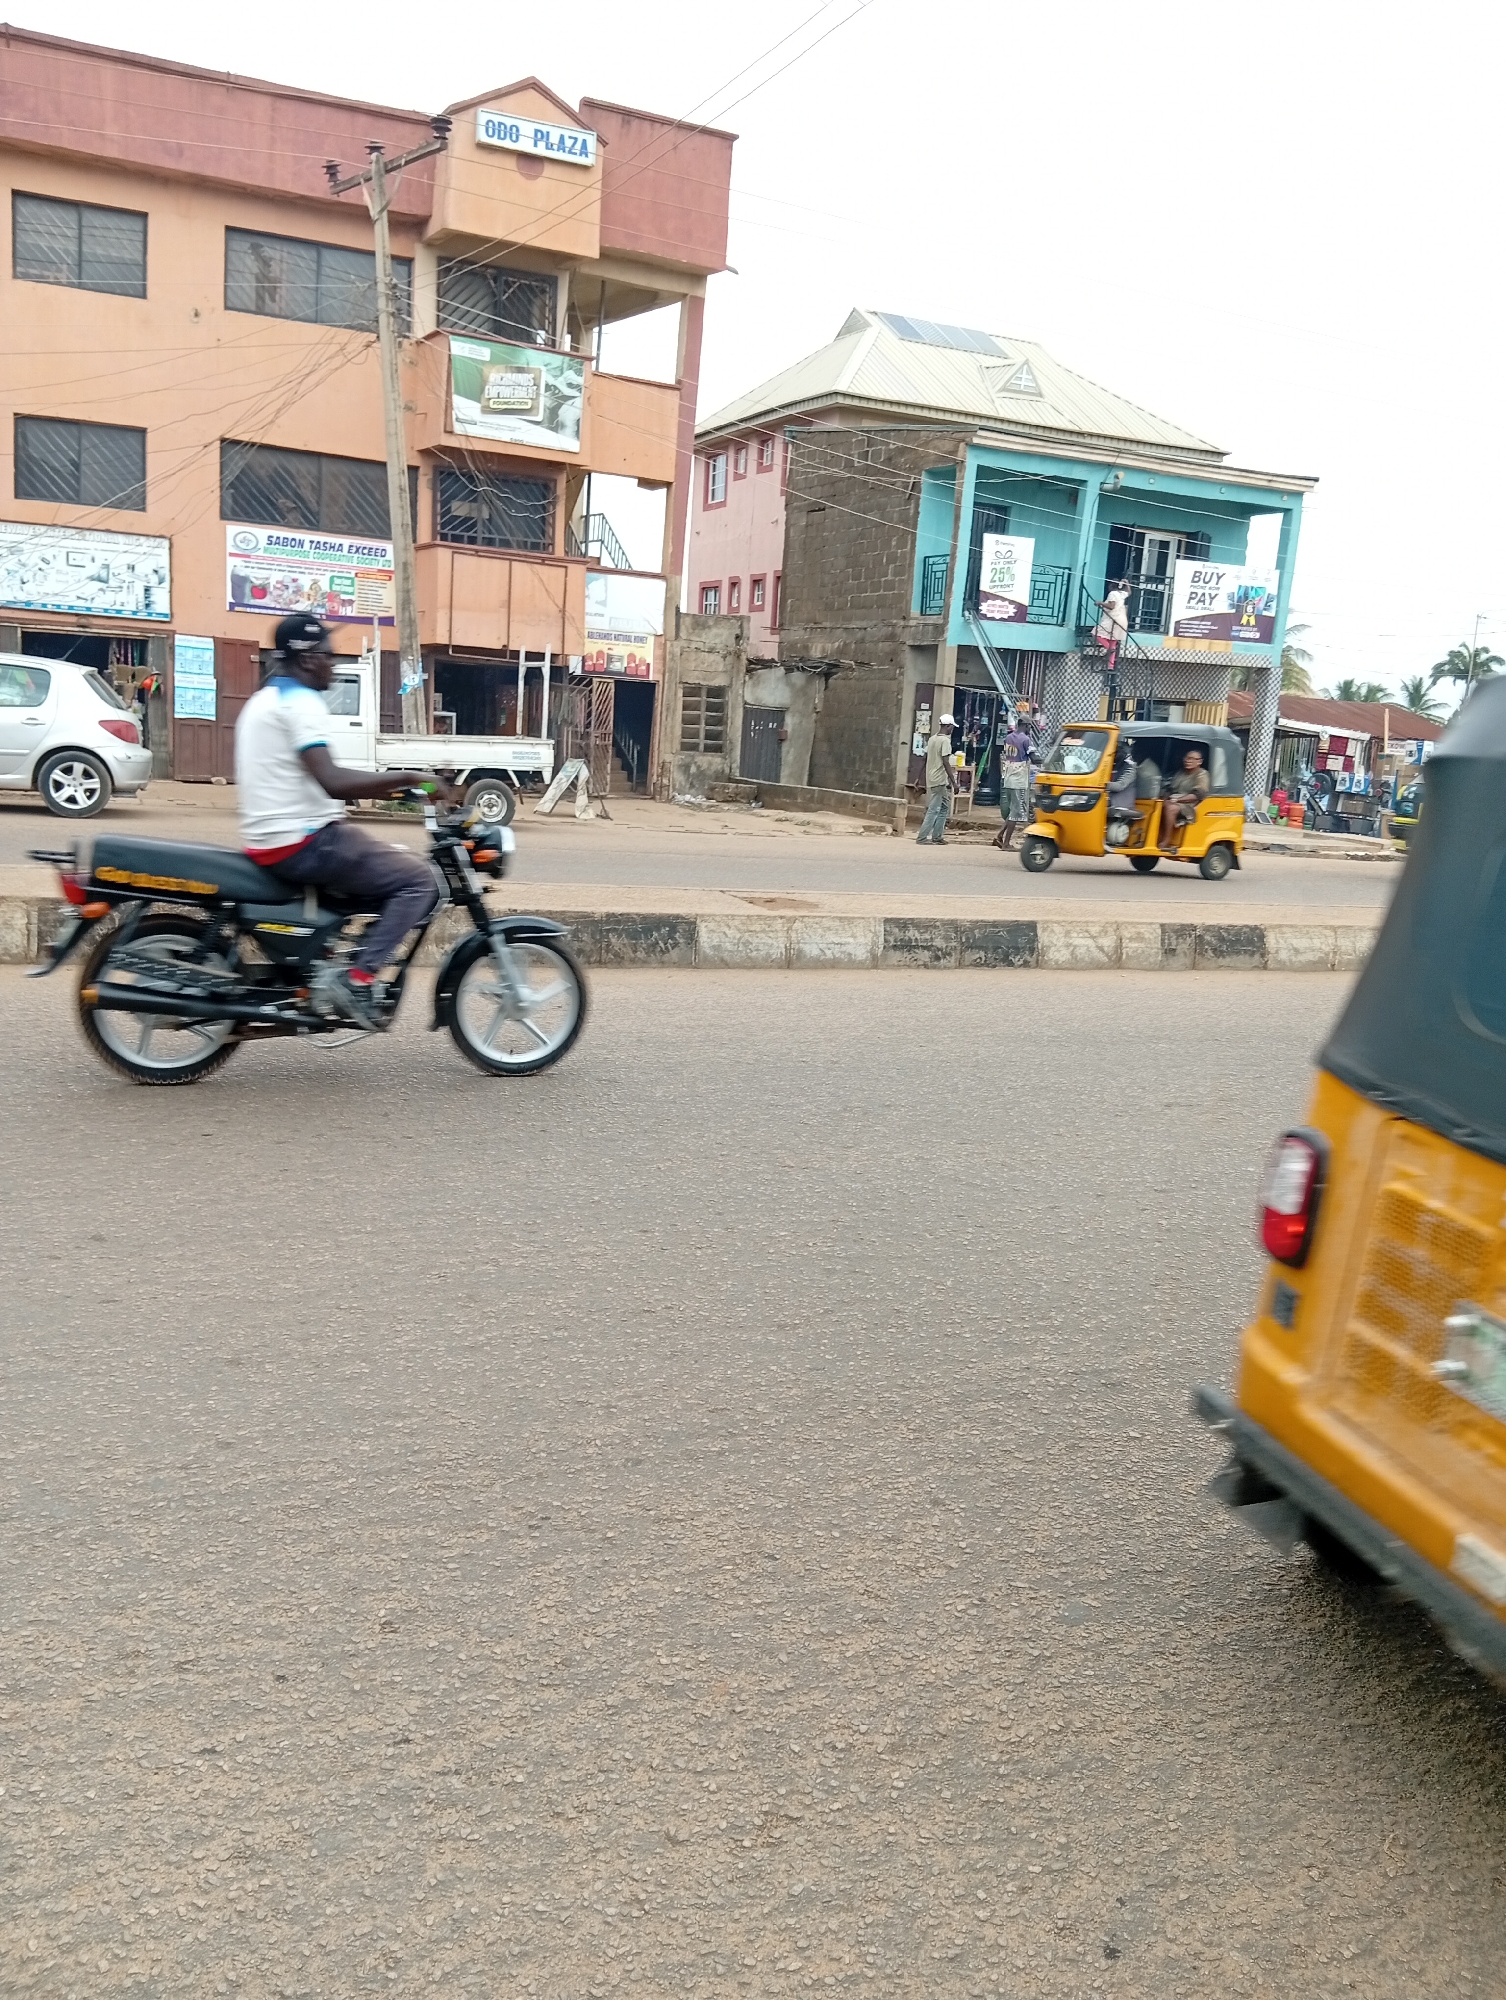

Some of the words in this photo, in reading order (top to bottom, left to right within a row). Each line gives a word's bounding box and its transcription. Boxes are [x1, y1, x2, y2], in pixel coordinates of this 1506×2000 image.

[485, 119, 520, 143] ODO
[533, 128, 589, 158] PLAZA
[484, 385, 538, 399] EMPOWERMENT
[266, 535, 306, 549] SABON
[309, 540, 344, 553] TASHA
[347, 544, 387, 558] EXCEED
[263, 546, 311, 559] MULTIPURPOSE
[312, 551, 355, 564] COOPERATIVE
[356, 556, 381, 567] SOCIETY
[382, 559, 392, 568] LTD
[990, 566, 1015, 583] 25%
[1191, 570, 1226, 585] BUY
[1187, 591, 1219, 606] PAY
